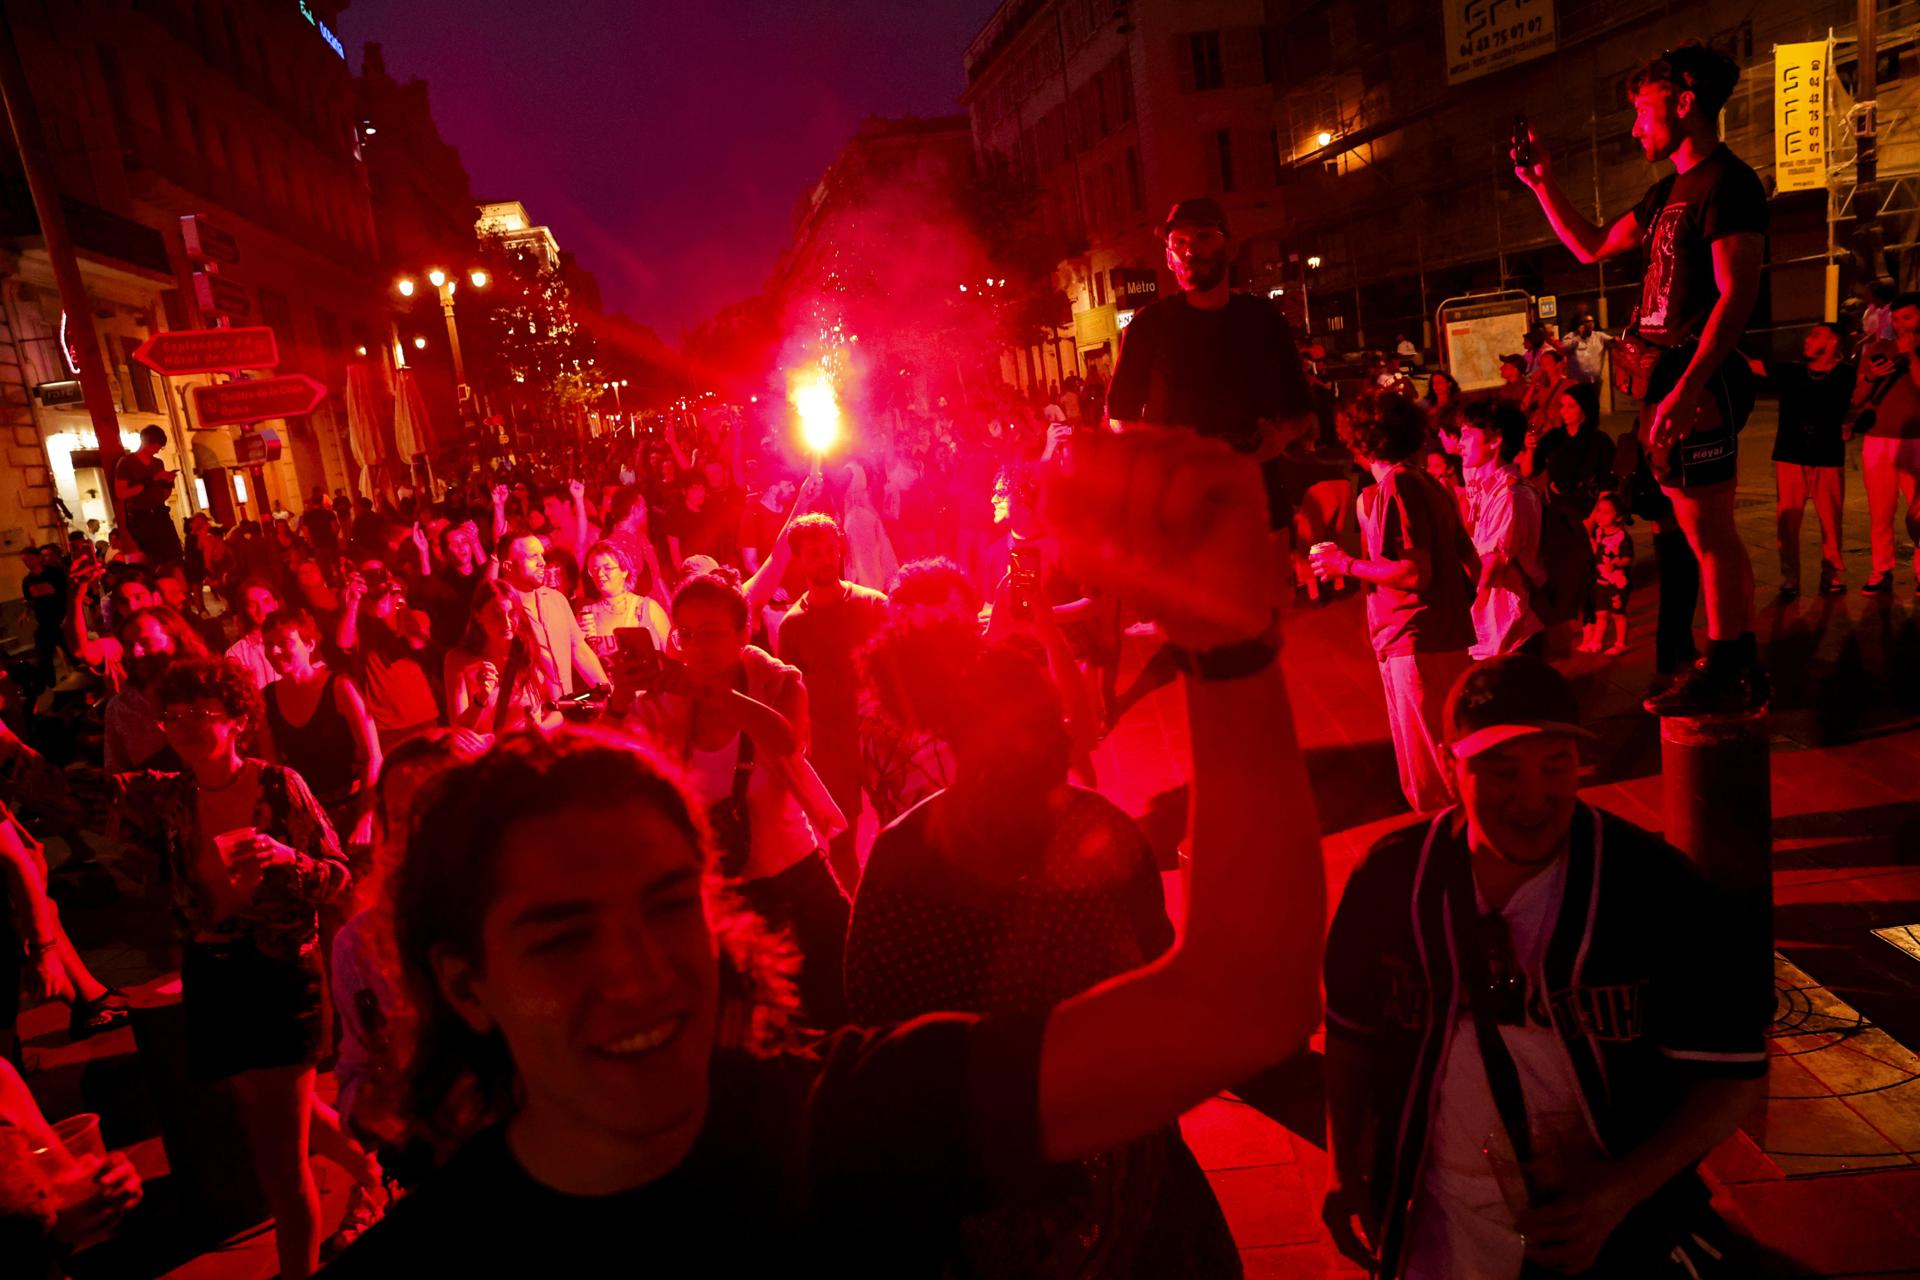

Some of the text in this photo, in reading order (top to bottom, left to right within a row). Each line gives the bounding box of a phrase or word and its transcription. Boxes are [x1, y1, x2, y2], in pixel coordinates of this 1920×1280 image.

[1460, 16, 1542, 56] 04 42 75 07 07
[1809, 76, 1820, 153] 04 42 75 07 07
[1127, 280, 1156, 294] Métro
